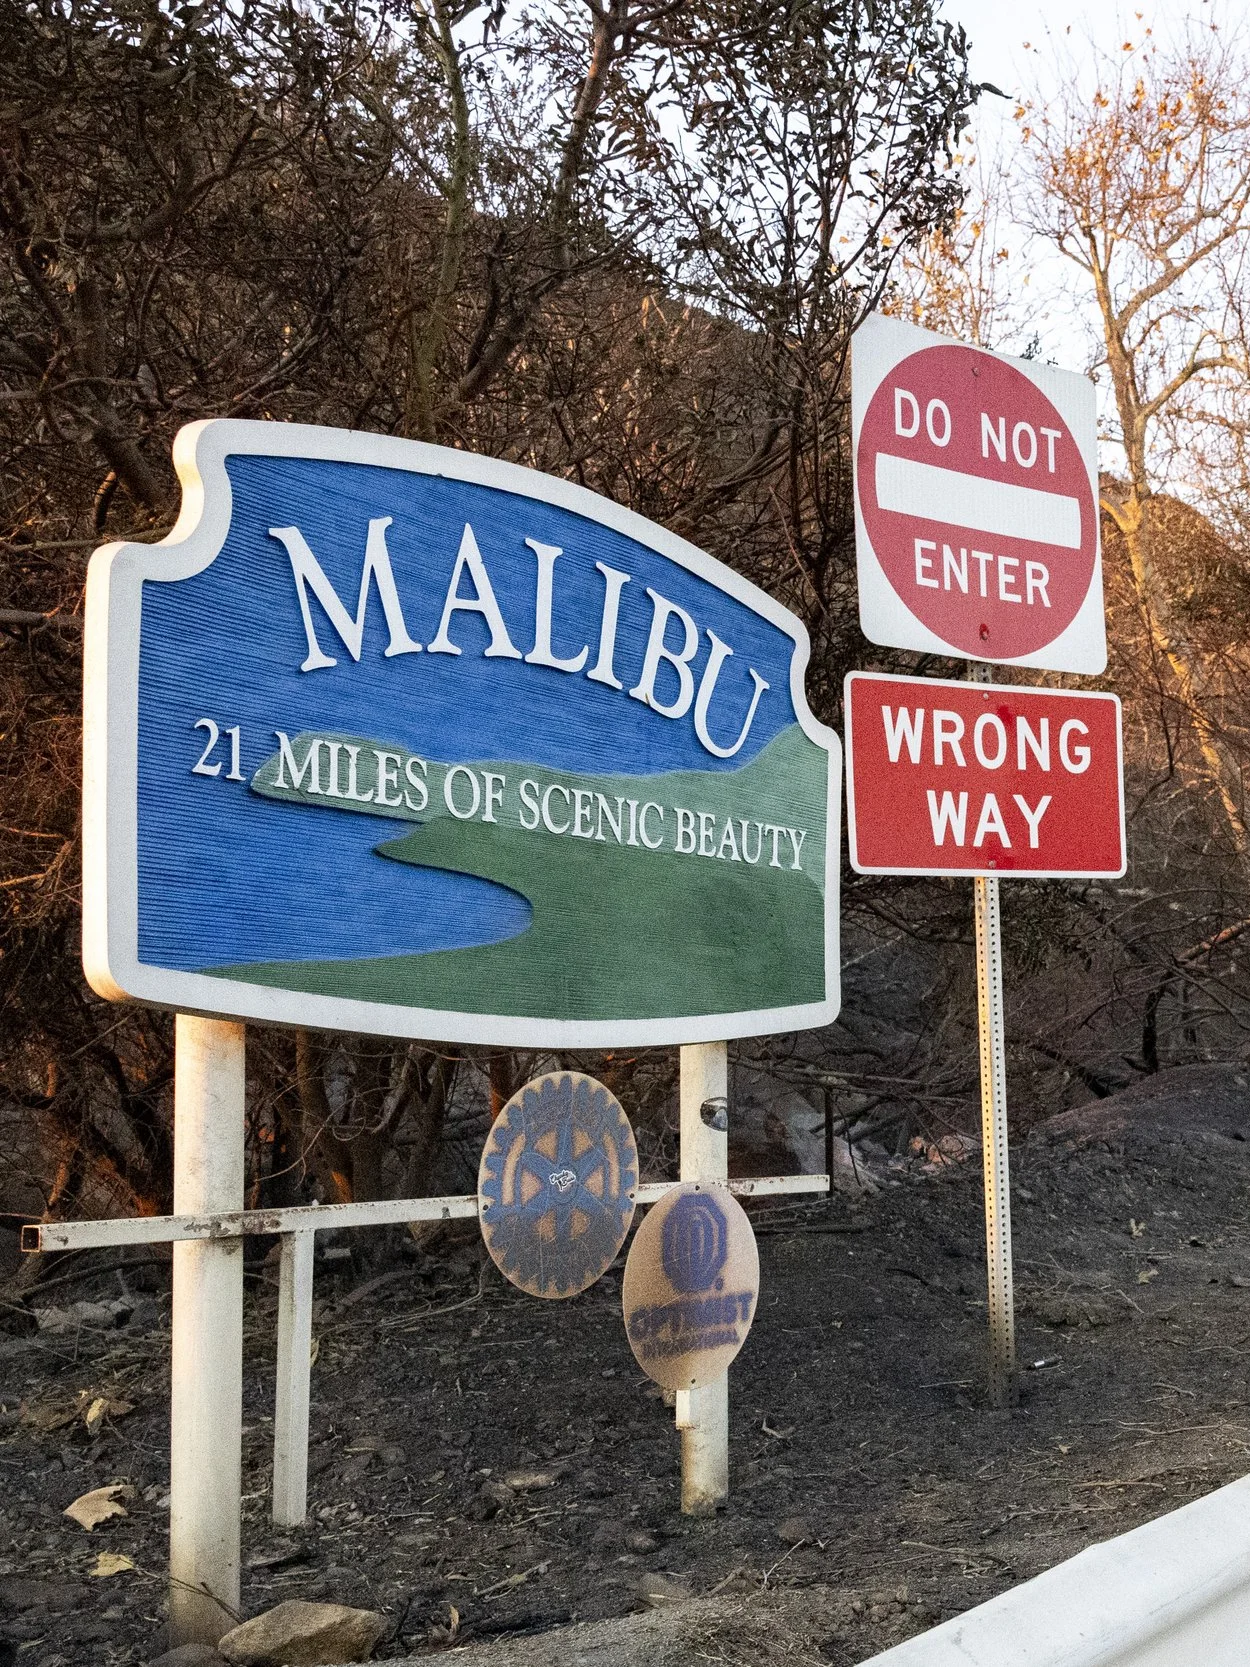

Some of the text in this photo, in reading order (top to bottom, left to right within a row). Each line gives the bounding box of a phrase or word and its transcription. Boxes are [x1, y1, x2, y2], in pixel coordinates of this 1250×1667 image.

[895, 388, 1062, 474] DO NOT
[914, 538, 1051, 608] ENTER
[268, 516, 770, 758] MALIBU
[882, 706, 1091, 774] WRONG
[191, 718, 806, 870] 21 MILES OF SCENIC BEAUTY
[927, 790, 1052, 848] WAY
